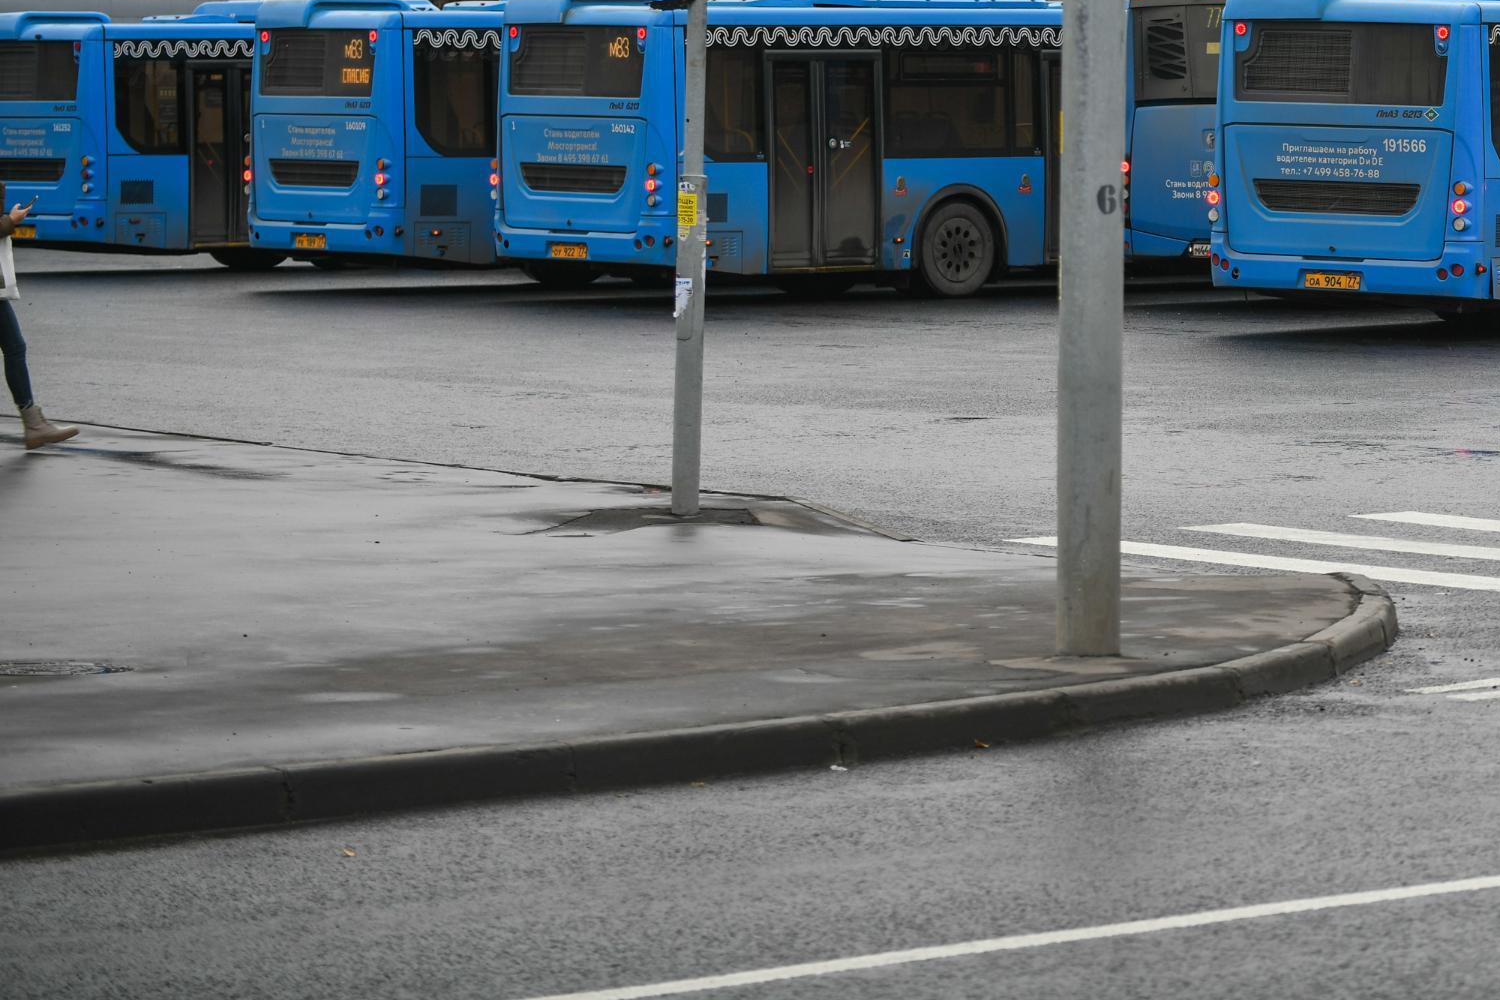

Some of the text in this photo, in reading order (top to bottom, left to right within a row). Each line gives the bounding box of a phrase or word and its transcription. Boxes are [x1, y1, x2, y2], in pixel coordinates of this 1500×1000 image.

[611, 123, 635, 134] 160142
[1282, 142, 1335, 155] Приглашаем
[1348, 147, 1378, 157] работу
[1383, 138, 1427, 153] 191566
[1318, 158, 1358, 167] категории
[1303, 167, 1312, 175] +7
[1314, 167, 1331, 177] 499
[1333, 168, 1380, 178] 458-76-88
[1165, 180, 1186, 188] Стань
[1096, 184, 1117, 215] 6
[1172, 191, 1195, 199] Звони
[1195, 191, 1201, 199] 8
[1324, 276, 1342, 288] 904
